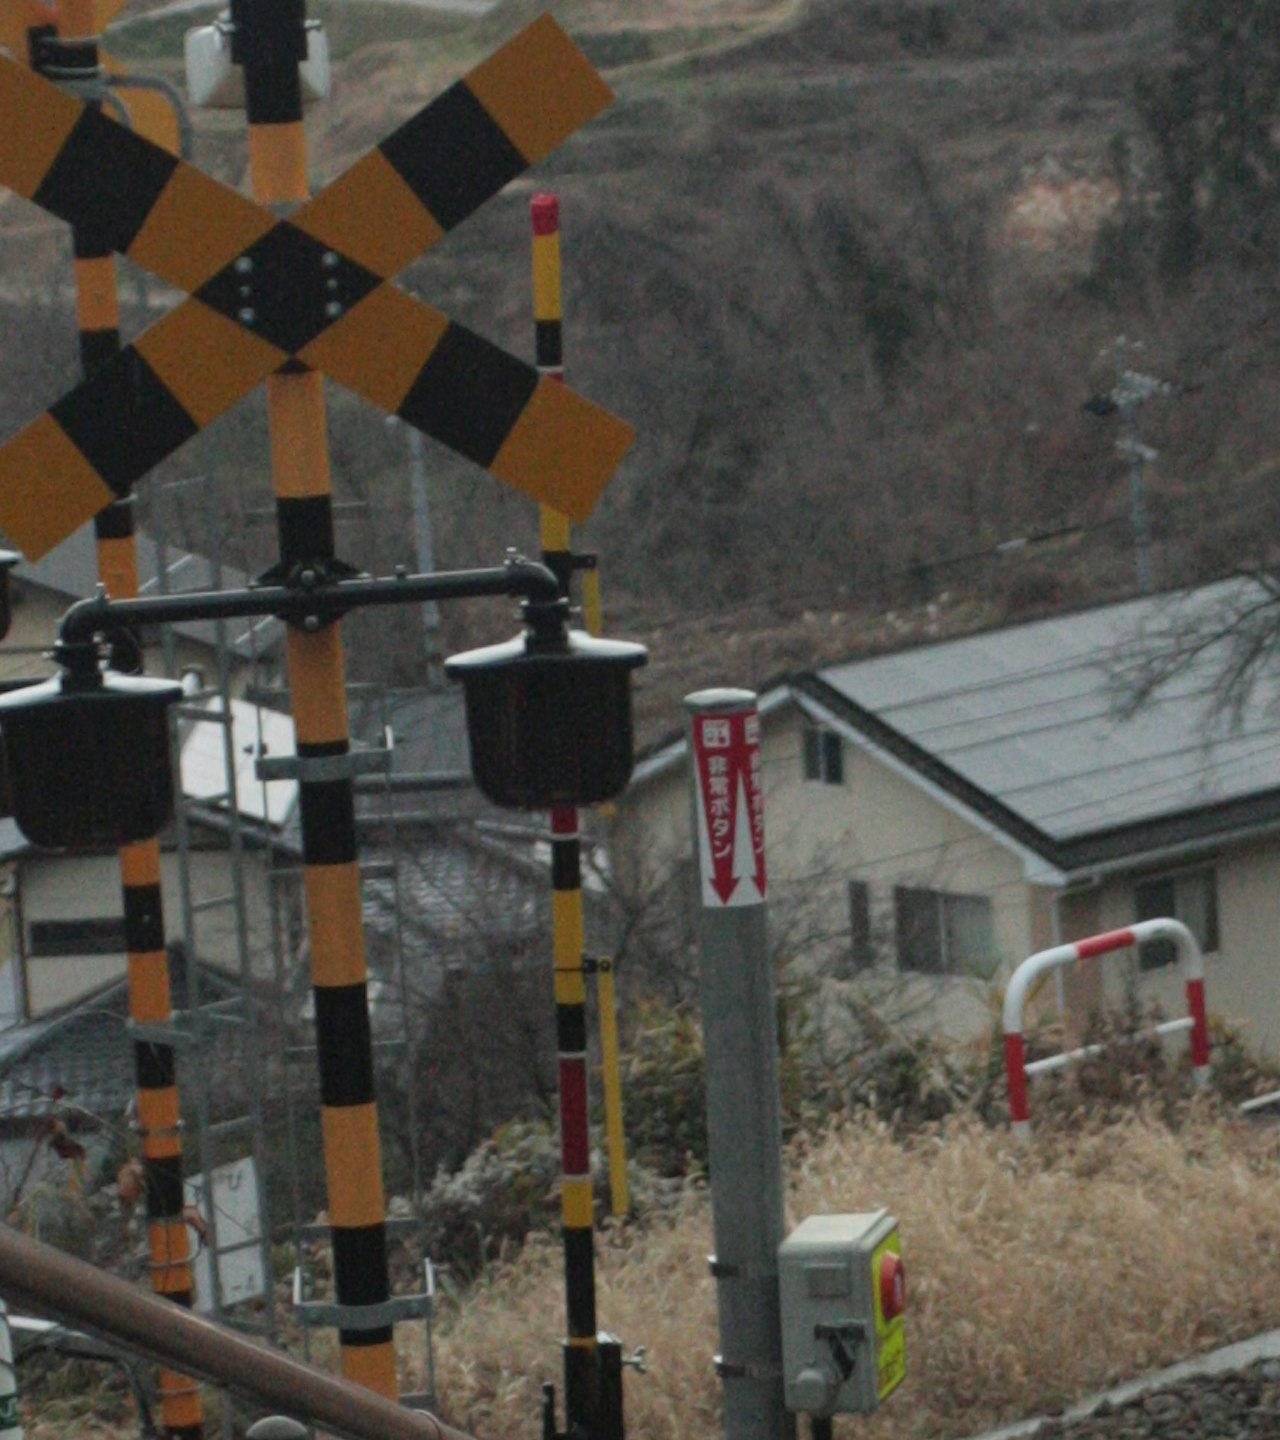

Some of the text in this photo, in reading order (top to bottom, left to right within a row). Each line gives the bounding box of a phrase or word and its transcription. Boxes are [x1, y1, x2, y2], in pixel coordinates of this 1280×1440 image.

[709, 756, 731, 858] 非常ボタン
